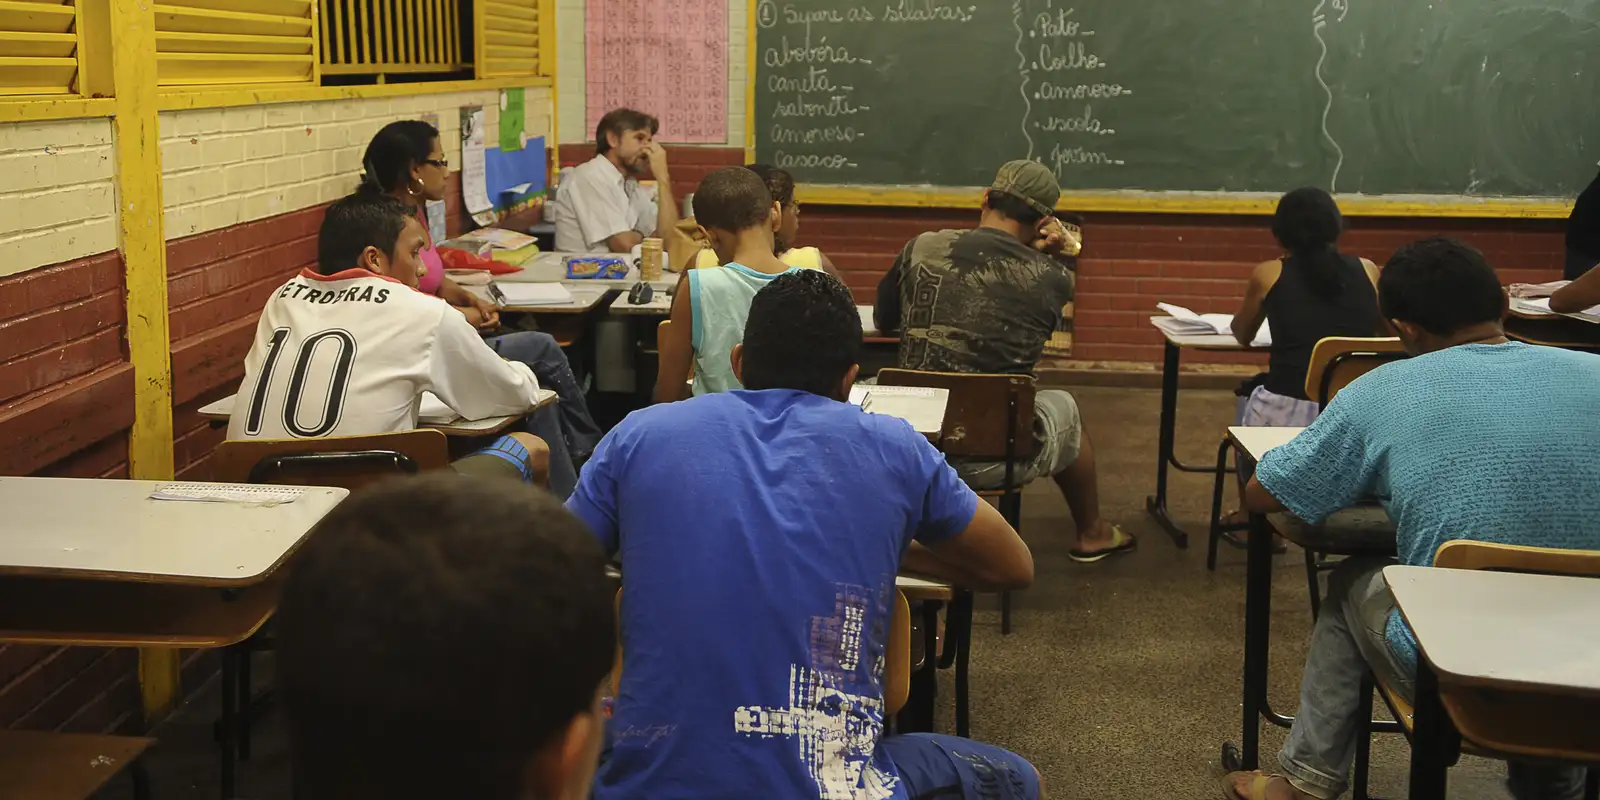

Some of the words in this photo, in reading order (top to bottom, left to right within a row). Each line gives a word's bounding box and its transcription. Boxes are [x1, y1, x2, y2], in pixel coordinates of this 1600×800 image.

[847, 6, 876, 22] as
[278, 281, 391, 305] ETROBRAS
[245, 327, 358, 440] 10
